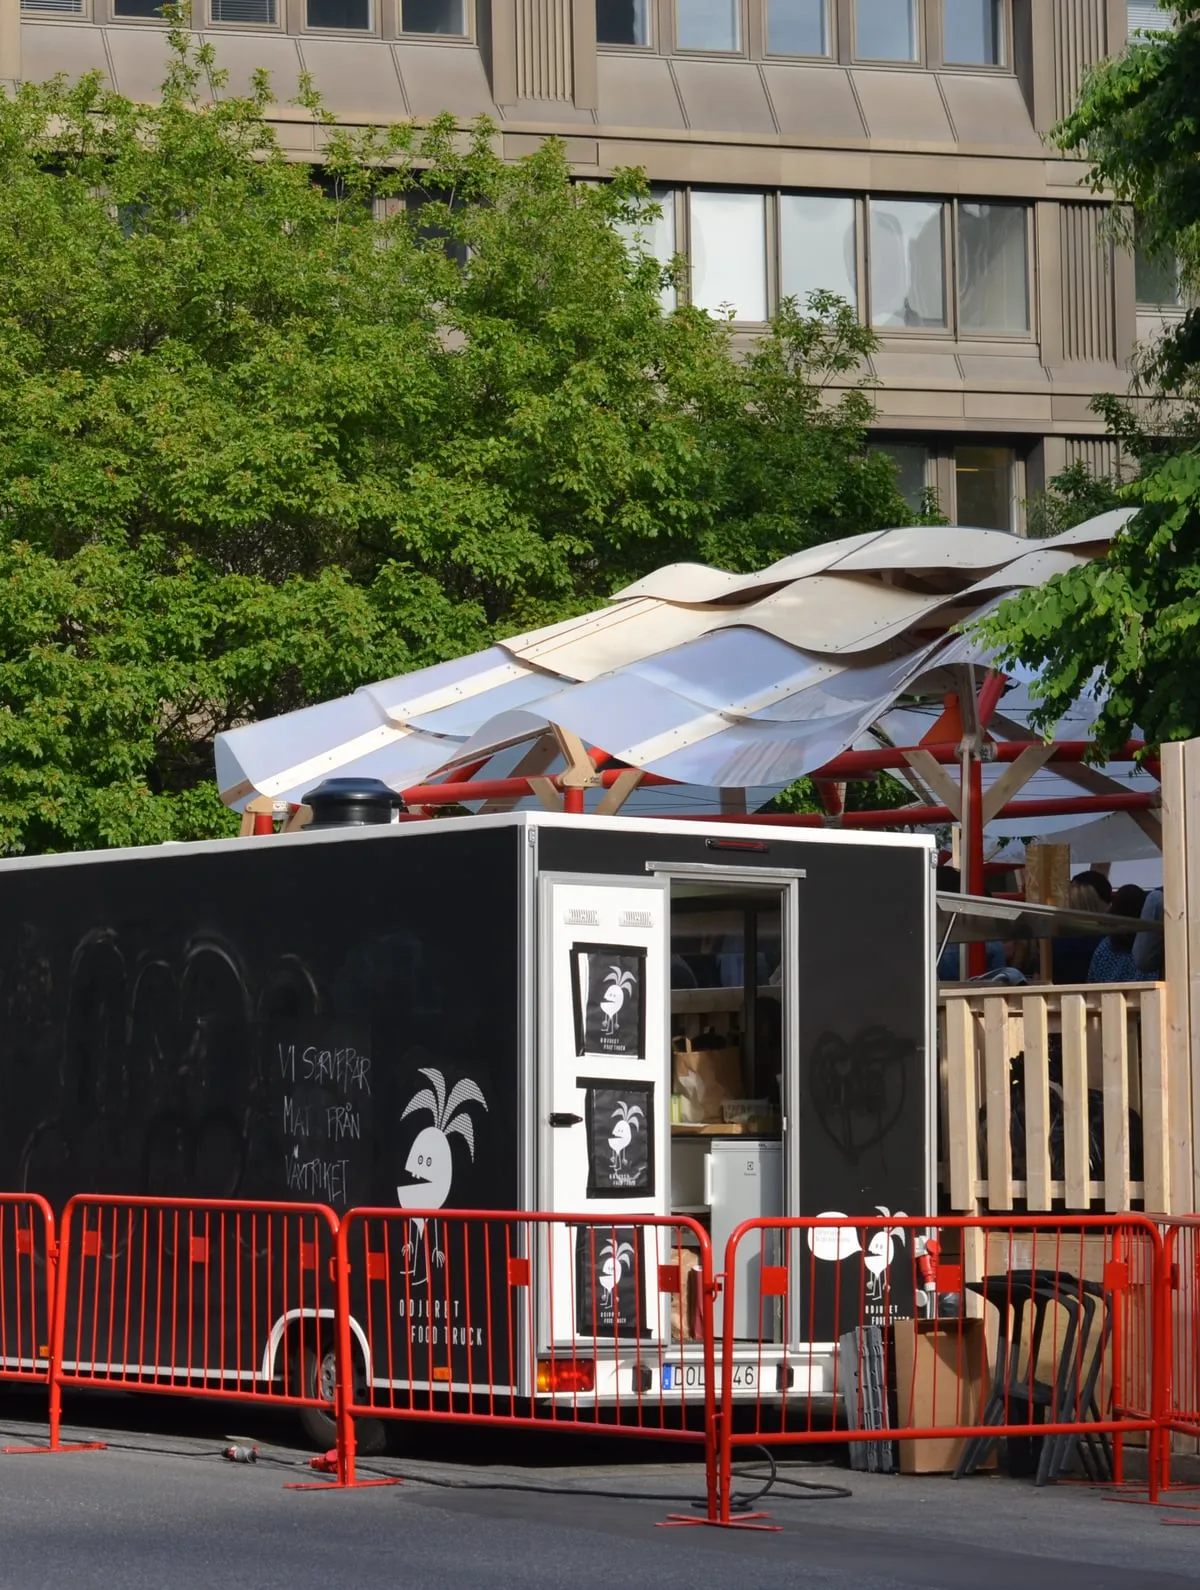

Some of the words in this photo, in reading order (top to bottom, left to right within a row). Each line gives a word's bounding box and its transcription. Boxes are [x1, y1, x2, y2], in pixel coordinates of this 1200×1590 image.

[279, 1043, 295, 1082] VI
[283, 1096, 313, 1136] MAT
[326, 1102, 360, 1142] FRÅN
[411, 1325, 438, 1344] FOOD
[444, 1326, 482, 1345] TRUCK
[732, 1365, 754, 1386] 46
